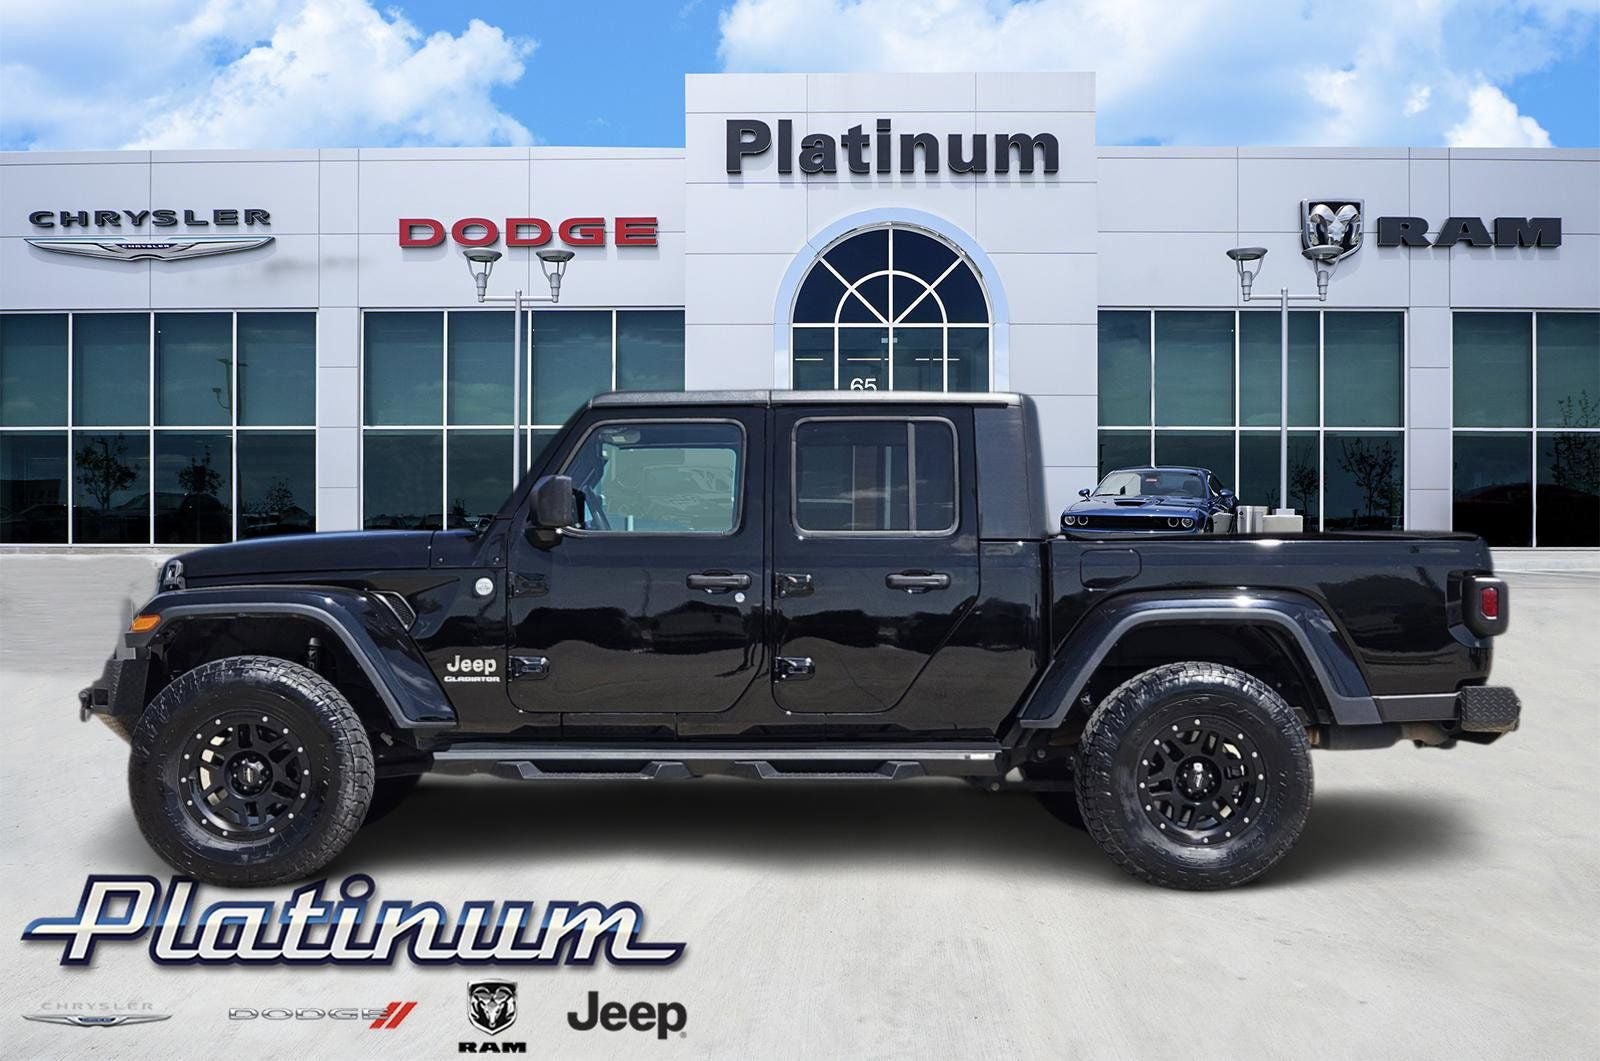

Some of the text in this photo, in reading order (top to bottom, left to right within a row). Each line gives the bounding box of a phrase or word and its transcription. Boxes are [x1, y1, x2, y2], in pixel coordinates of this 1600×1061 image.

[726, 118, 1059, 174] Platinum
[29, 209, 271, 227] CHRYSLER
[399, 217, 657, 247] DODGE
[1377, 216, 1562, 248] RAM
[446, 654, 497, 675] Jeep
[443, 675, 501, 683] GLADIATOR
